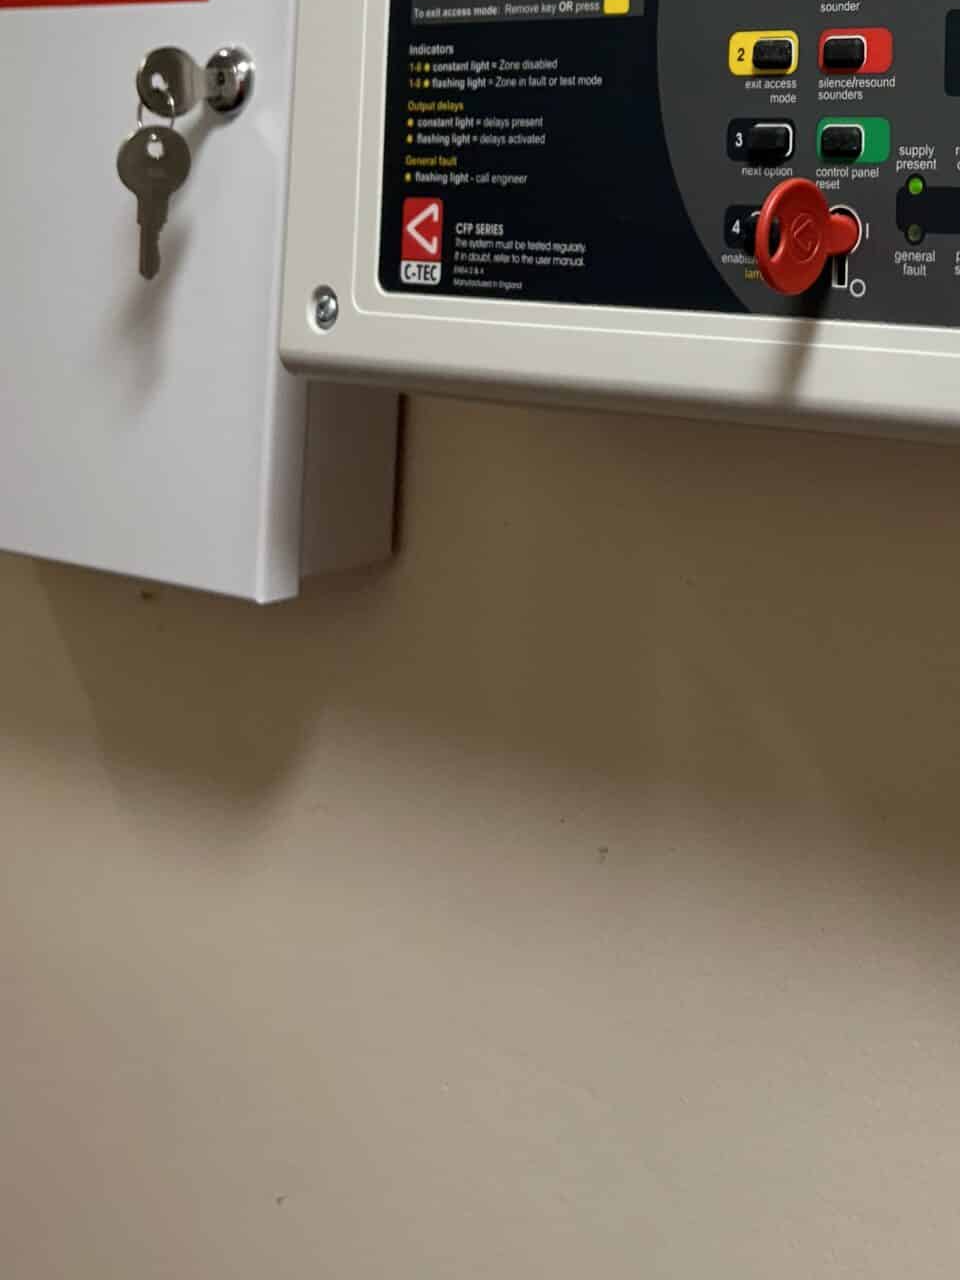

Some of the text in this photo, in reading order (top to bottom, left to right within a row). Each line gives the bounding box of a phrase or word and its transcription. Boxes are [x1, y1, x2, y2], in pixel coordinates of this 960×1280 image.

[559, 1, 573, 12] OR
[820, 1, 860, 13] sounder
[409, 44, 454, 56] Indicators
[737, 48, 745, 62] 2
[578, 74, 603, 86] mode
[745, 77, 797, 89] exit access
[818, 76, 896, 90] silence/resound
[770, 93, 797, 103] mode
[818, 89, 863, 101] sounders
[736, 133, 743, 147] 3
[899, 144, 935, 157] supply
[896, 158, 936, 171] present
[741, 166, 793, 177] next option
[816, 167, 880, 180] control panel
[816, 179, 840, 189] reset
[455, 223, 504, 236] CFP SERIES
[732, 220, 740, 234] 4
[894, 250, 936, 263] general
[404, 263, 436, 281] C-TEC
[903, 263, 927, 276] fault
